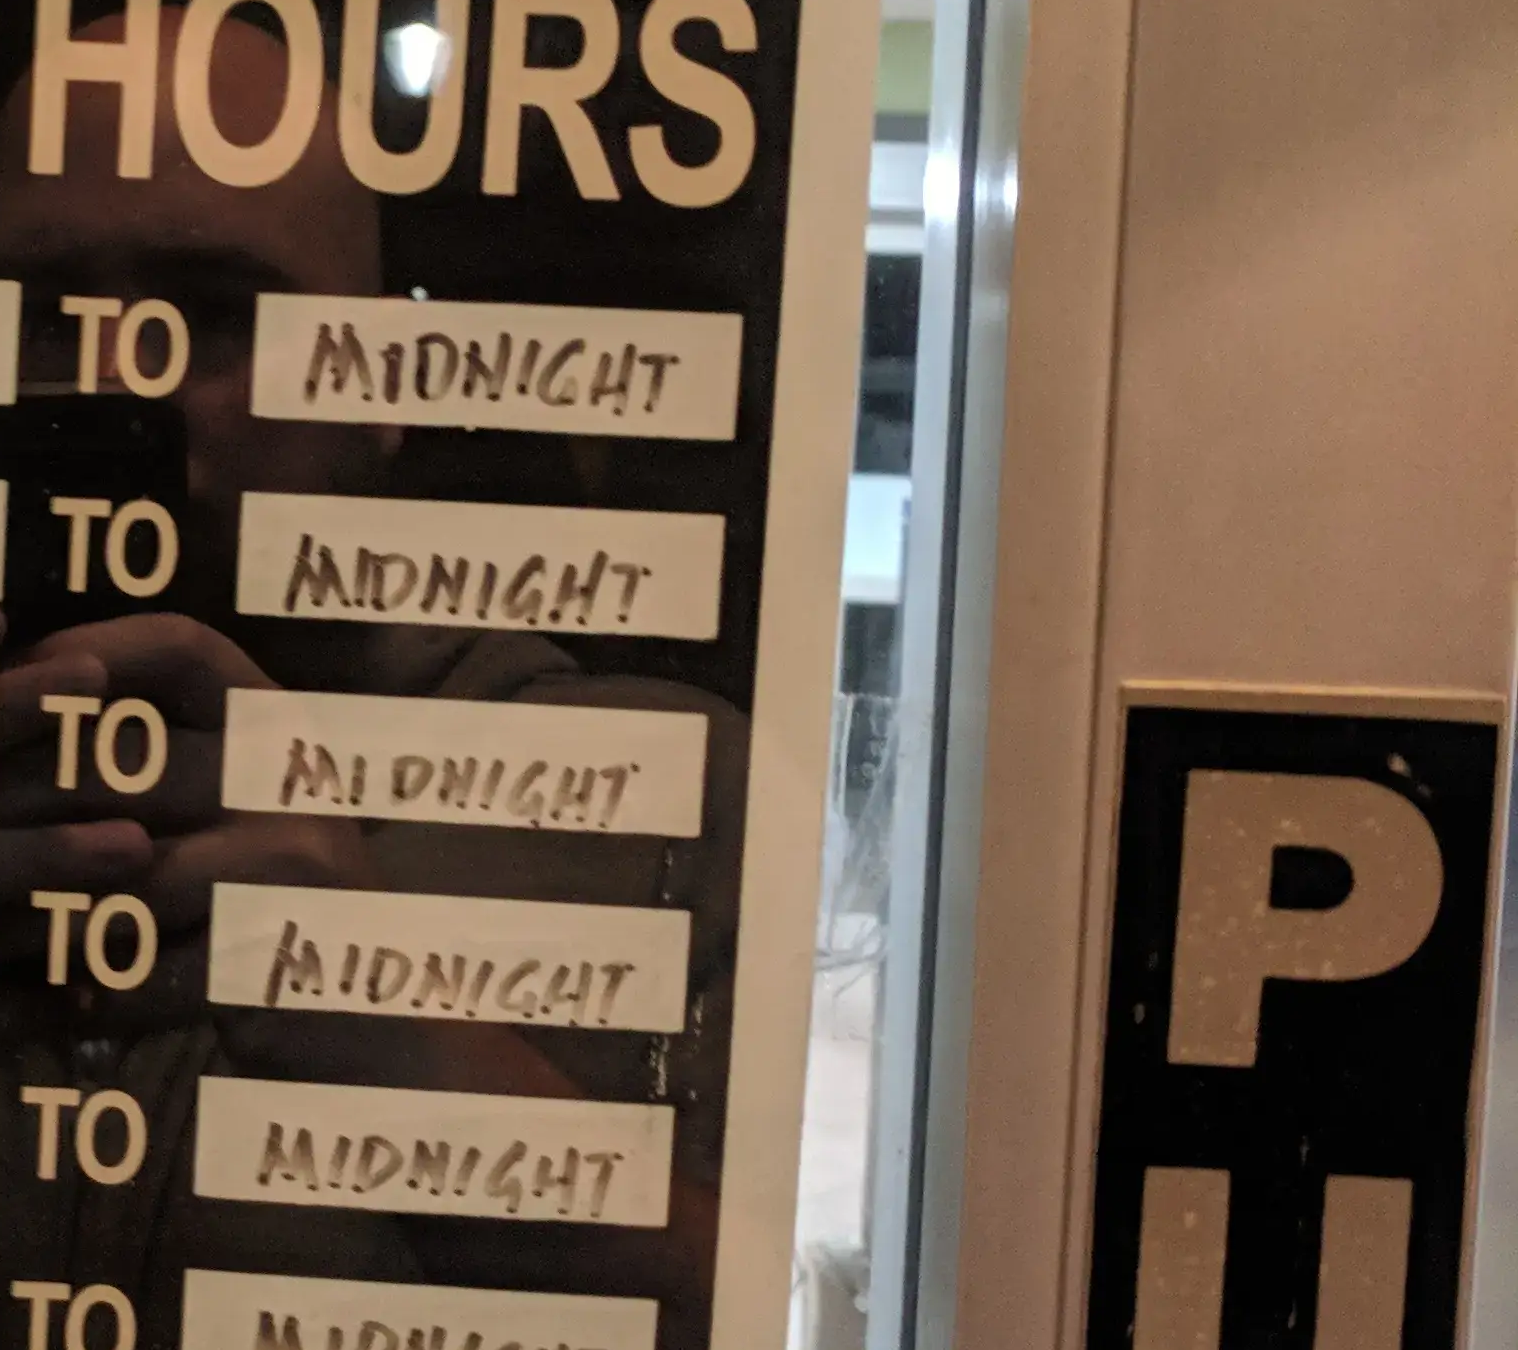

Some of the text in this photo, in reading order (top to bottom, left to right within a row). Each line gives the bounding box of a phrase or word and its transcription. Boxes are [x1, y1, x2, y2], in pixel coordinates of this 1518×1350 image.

[62, 297, 189, 397] TO
[304, 323, 679, 416] MIDNIGHT
[52, 498, 177, 596] TO
[284, 534, 651, 625] MIDNIGHT
[42, 695, 166, 793] TO
[279, 739, 641, 829] MIDNIGHT
[33, 892, 156, 989] TO
[265, 920, 635, 1026] MIDNIGHT
[22, 1087, 146, 1184] TO
[258, 1122, 624, 1217] MIDNIGHT
